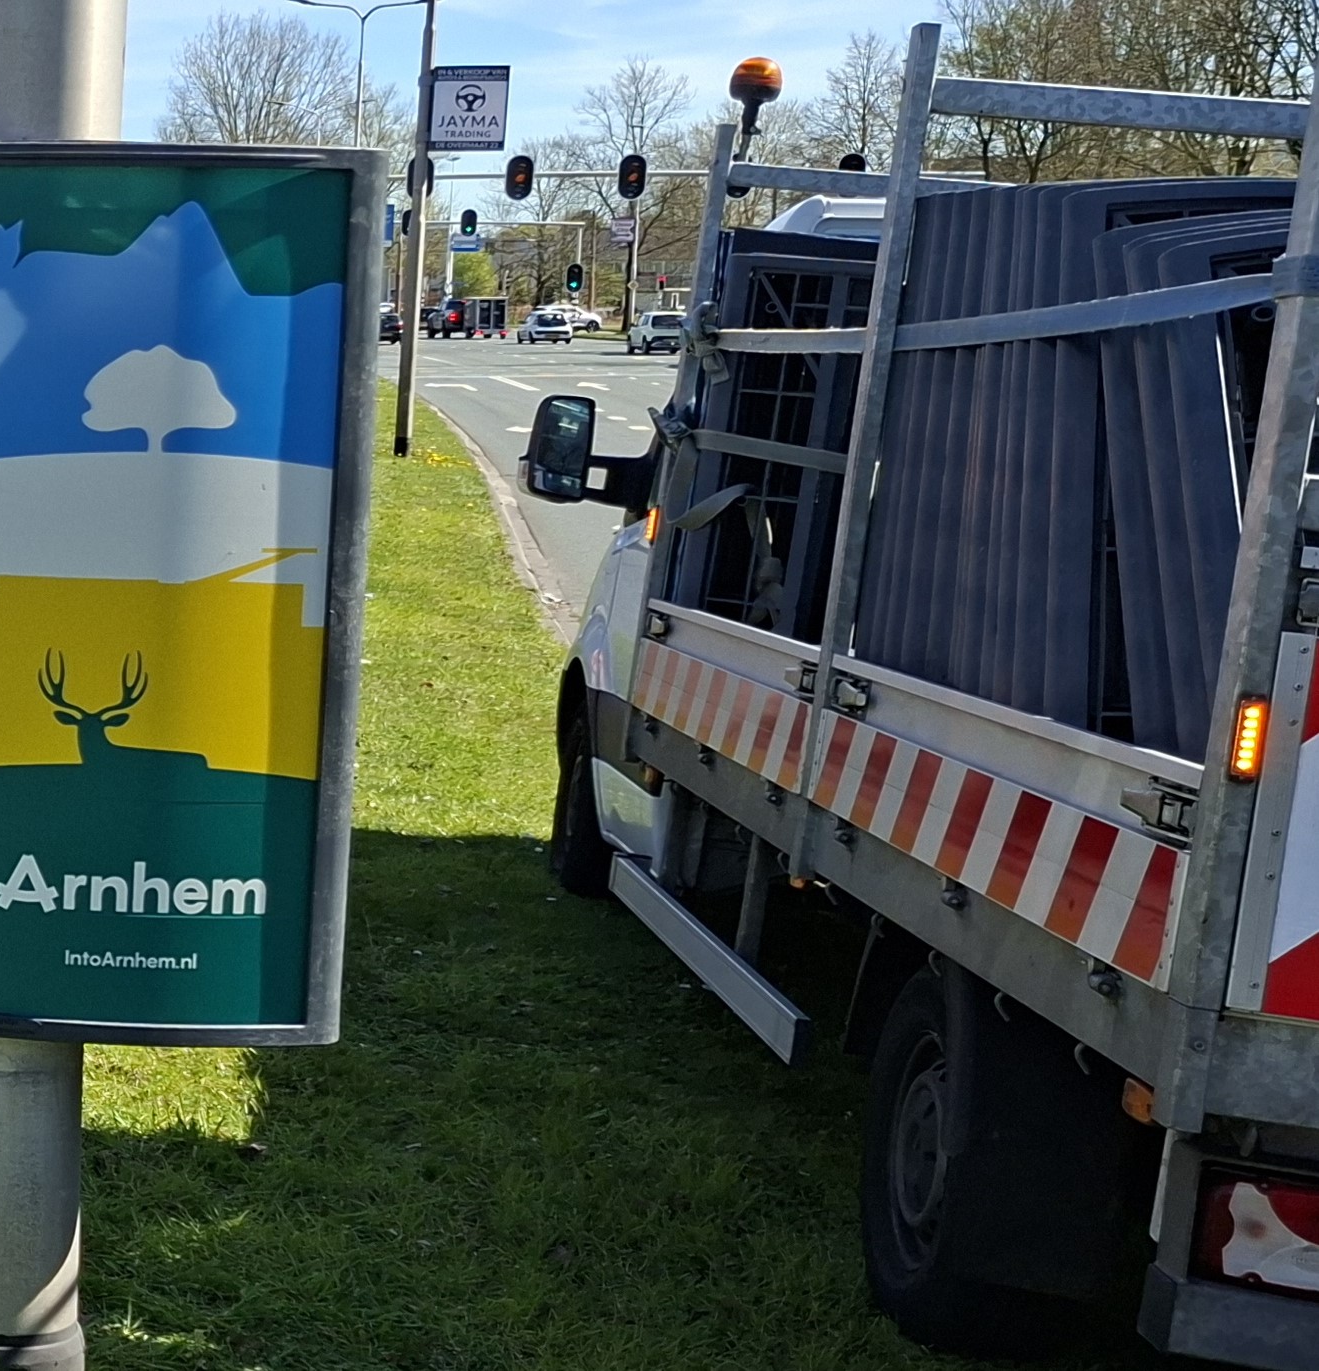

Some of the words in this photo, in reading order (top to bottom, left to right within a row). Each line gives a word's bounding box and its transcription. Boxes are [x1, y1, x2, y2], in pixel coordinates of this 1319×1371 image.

[438, 115, 499, 128] JAYMA
[445, 130, 491, 138] TRADING
[64, 949, 197, 970] IntoArnhem.nl
